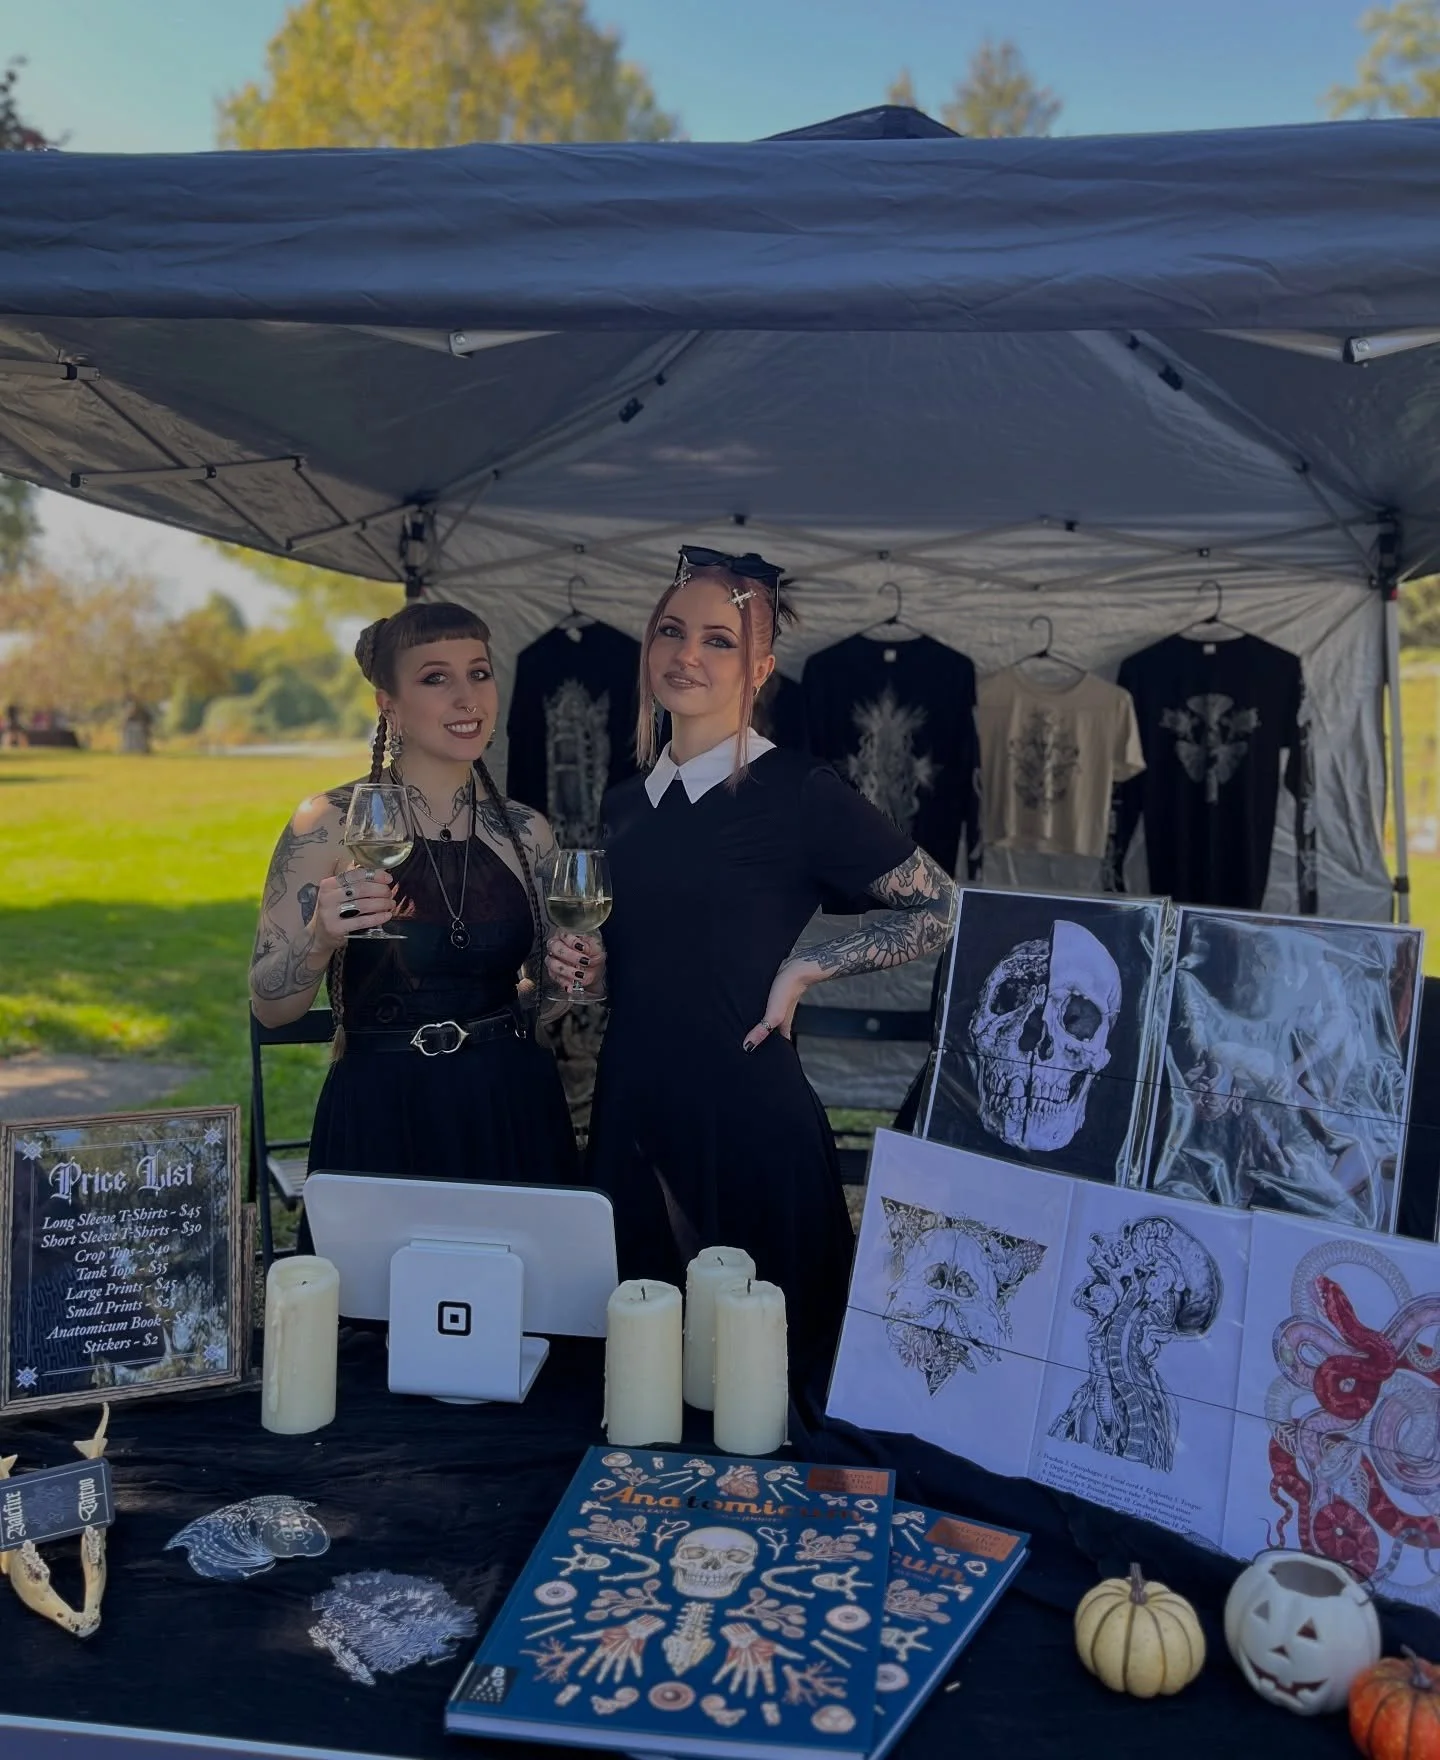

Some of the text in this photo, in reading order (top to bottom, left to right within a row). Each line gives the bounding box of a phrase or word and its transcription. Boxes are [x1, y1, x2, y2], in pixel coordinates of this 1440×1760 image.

[49, 1149, 194, 1207] Price List
[42, 1216, 74, 1231] Long
[77, 1213, 116, 1227] Sleeve
[119, 1208, 168, 1222] T-Shirts
[179, 1204, 201, 1218] $45
[41, 1234, 75, 1248] Short
[79, 1231, 118, 1245] Sleeve
[122, 1226, 169, 1240] T-Shirts
[181, 1222, 202, 1236] $30
[74, 1250, 105, 1264] Crop
[109, 1246, 135, 1261] Tops
[147, 1244, 170, 1257] $40
[77, 1267, 107, 1281] Tank
[110, 1263, 136, 1278] Tops
[149, 1261, 169, 1275] $35
[66, 1287, 102, 1302] Large
[106, 1282, 143, 1296] Prints
[155, 1279, 177, 1293] $45
[66, 1302, 102, 1319] Small
[106, 1300, 143, 1314] Prints
[155, 1297, 176, 1309] $25
[46, 1321, 128, 1340] Anatomicum
[131, 1315, 161, 1329] Book
[83, 1337, 131, 1354] Stickers
[143, 1334, 158, 1347] $2
[78, 1477, 105, 1522] Tattoo
